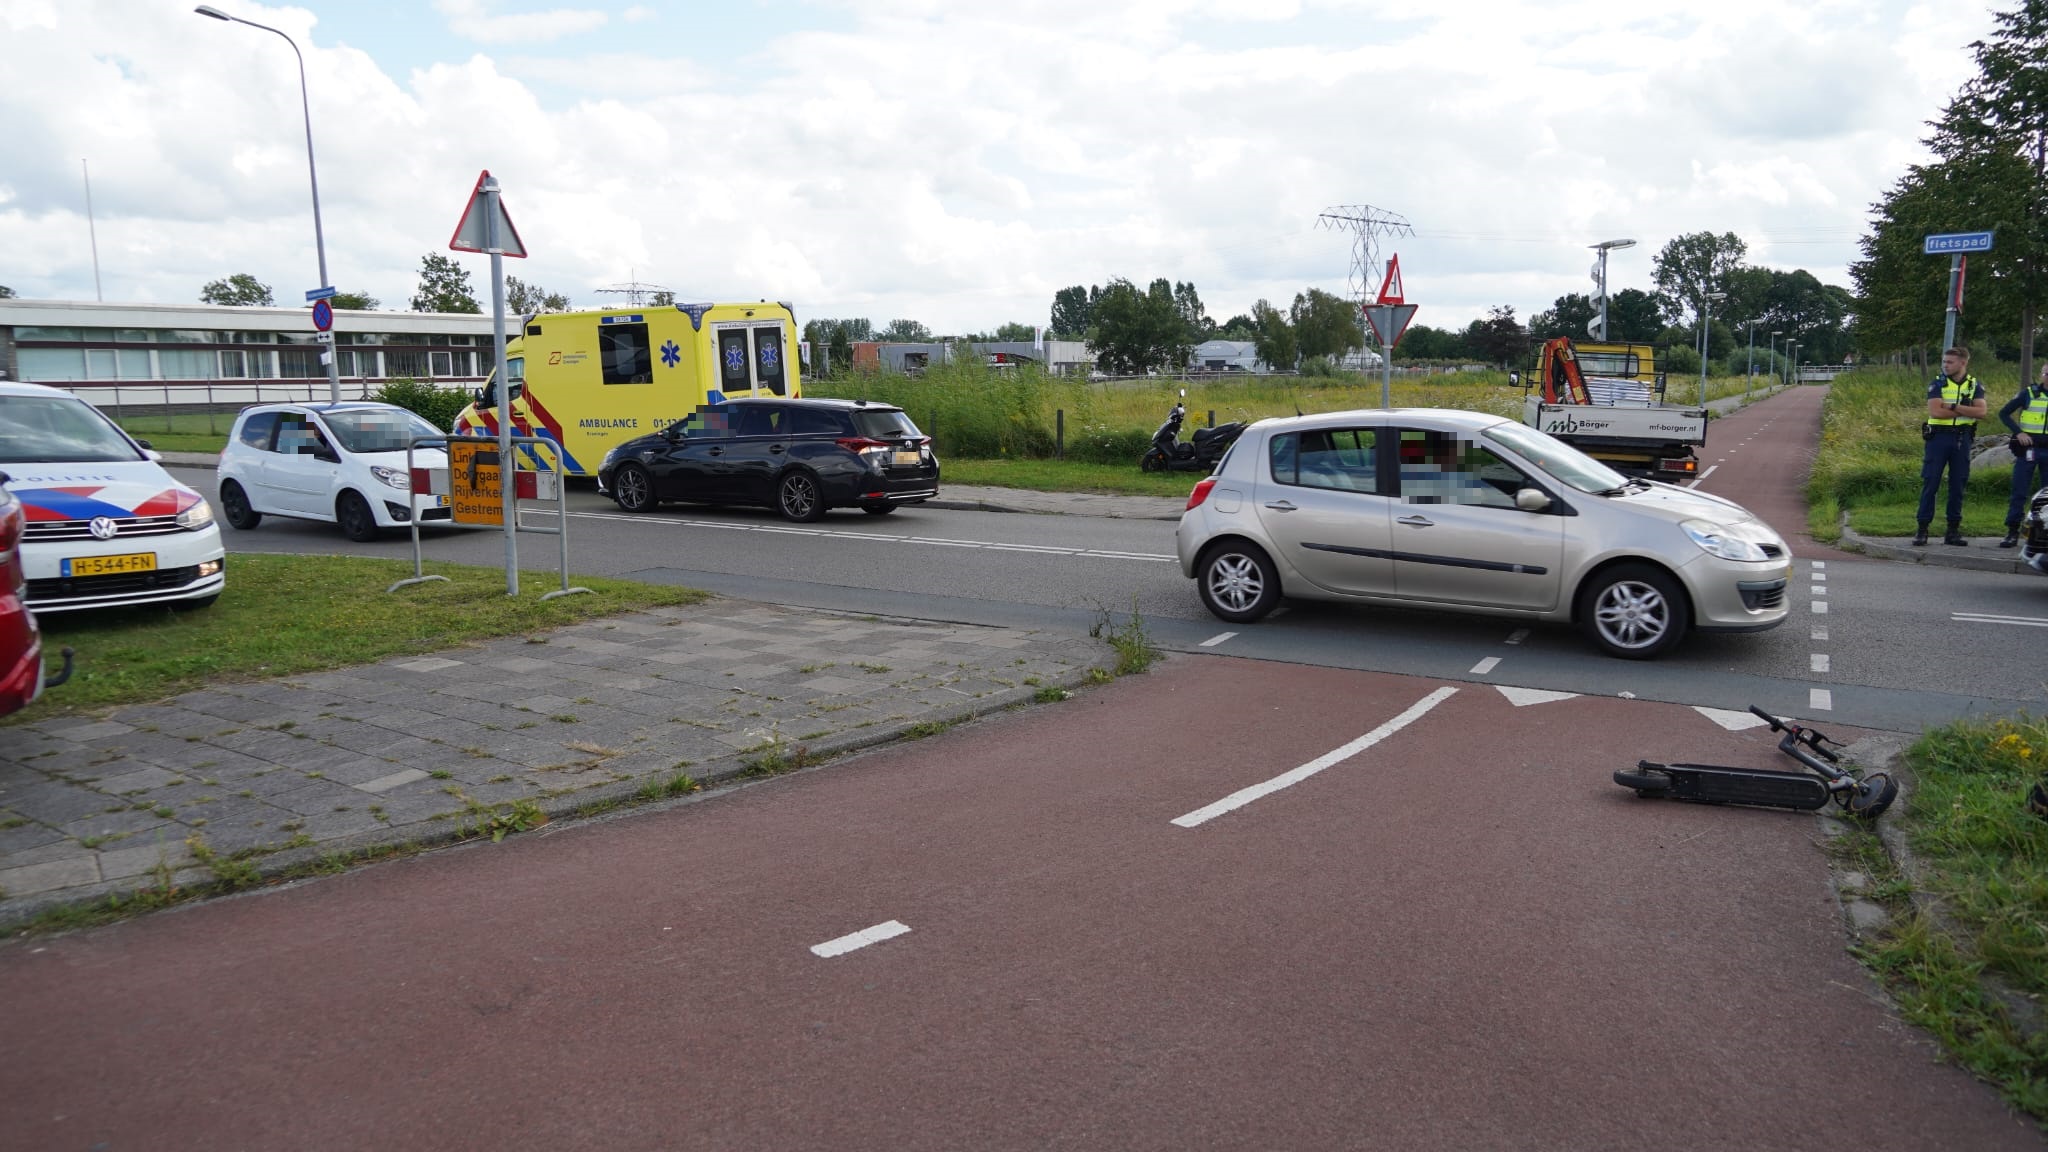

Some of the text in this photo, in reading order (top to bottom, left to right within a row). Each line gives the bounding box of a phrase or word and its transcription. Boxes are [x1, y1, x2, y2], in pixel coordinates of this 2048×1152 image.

[1929, 236, 1987, 249] fietspad
[579, 418, 638, 428] AMBULANCE
[1579, 420, 1609, 429] Borger
[1649, 424, 1697, 433] mf-borger.nl
[11, 475, 117, 483] POLITIE
[456, 502, 503, 515] Gestrem
[75, 556, 150, 574] H-544-FN
